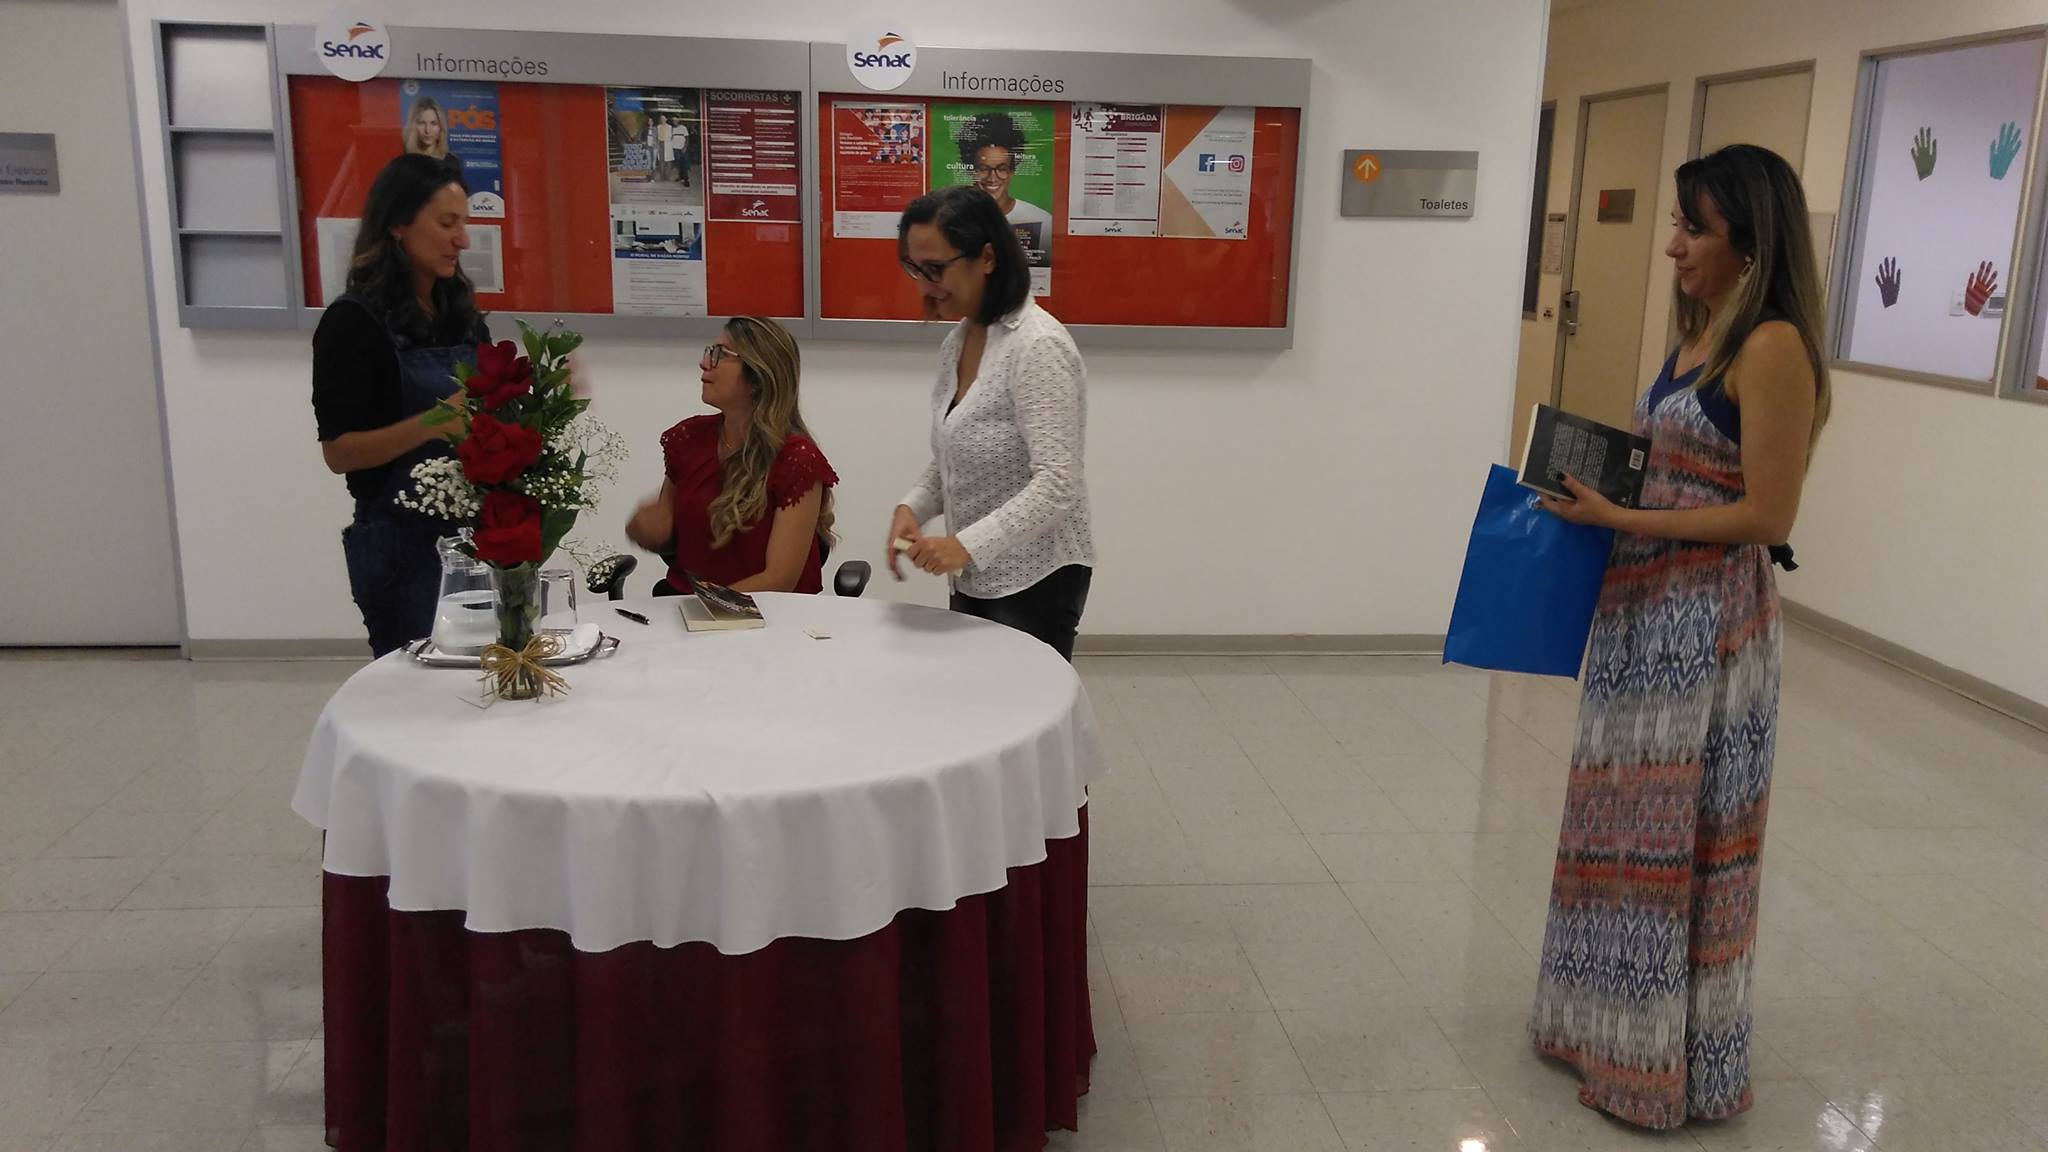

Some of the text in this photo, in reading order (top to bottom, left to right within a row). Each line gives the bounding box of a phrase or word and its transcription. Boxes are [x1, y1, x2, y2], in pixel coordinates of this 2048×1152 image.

[323, 41, 384, 59] Senac
[853, 51, 911, 68] Senac
[416, 53, 549, 79] Informações
[942, 71, 1065, 96] Informações
[709, 91, 779, 103] SOCORRISTAS
[448, 104, 497, 130] PÓS
[1120, 113, 1158, 121] BRIGADA
[1014, 152, 1037, 160] leitura
[946, 162, 975, 170] cultura
[472, 203, 496, 211] Senac
[1420, 198, 1469, 211] Toaletes
[741, 208, 769, 217] Senac
